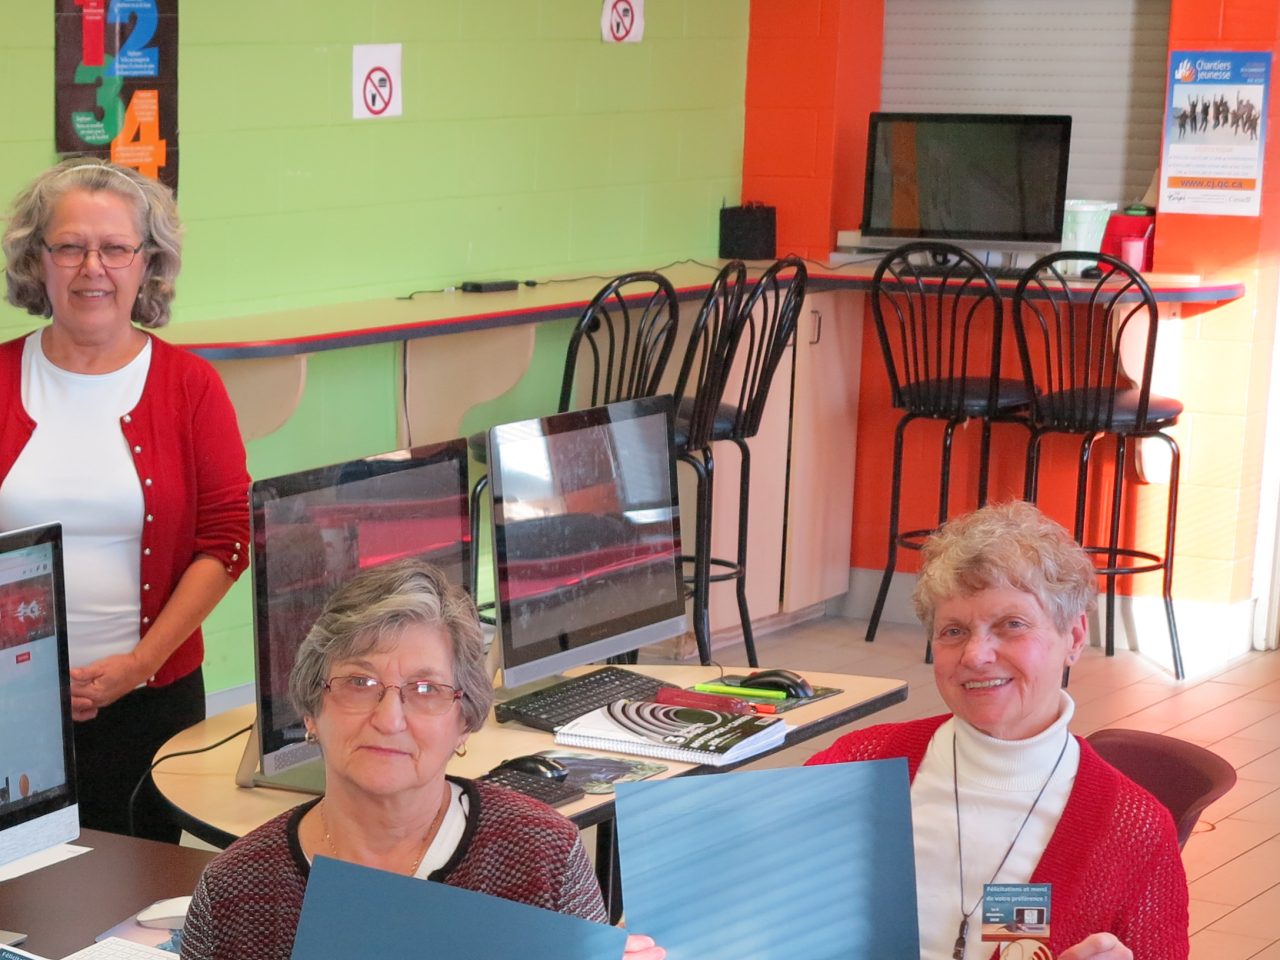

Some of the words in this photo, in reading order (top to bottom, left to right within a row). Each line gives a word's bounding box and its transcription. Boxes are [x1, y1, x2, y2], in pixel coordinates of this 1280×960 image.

[1196, 60, 1232, 71] Chantiers
[71, 53, 125, 145] 3
[111, 90, 167, 180] 4
[1181, 179, 1243, 190] www.cj.qc.ca
